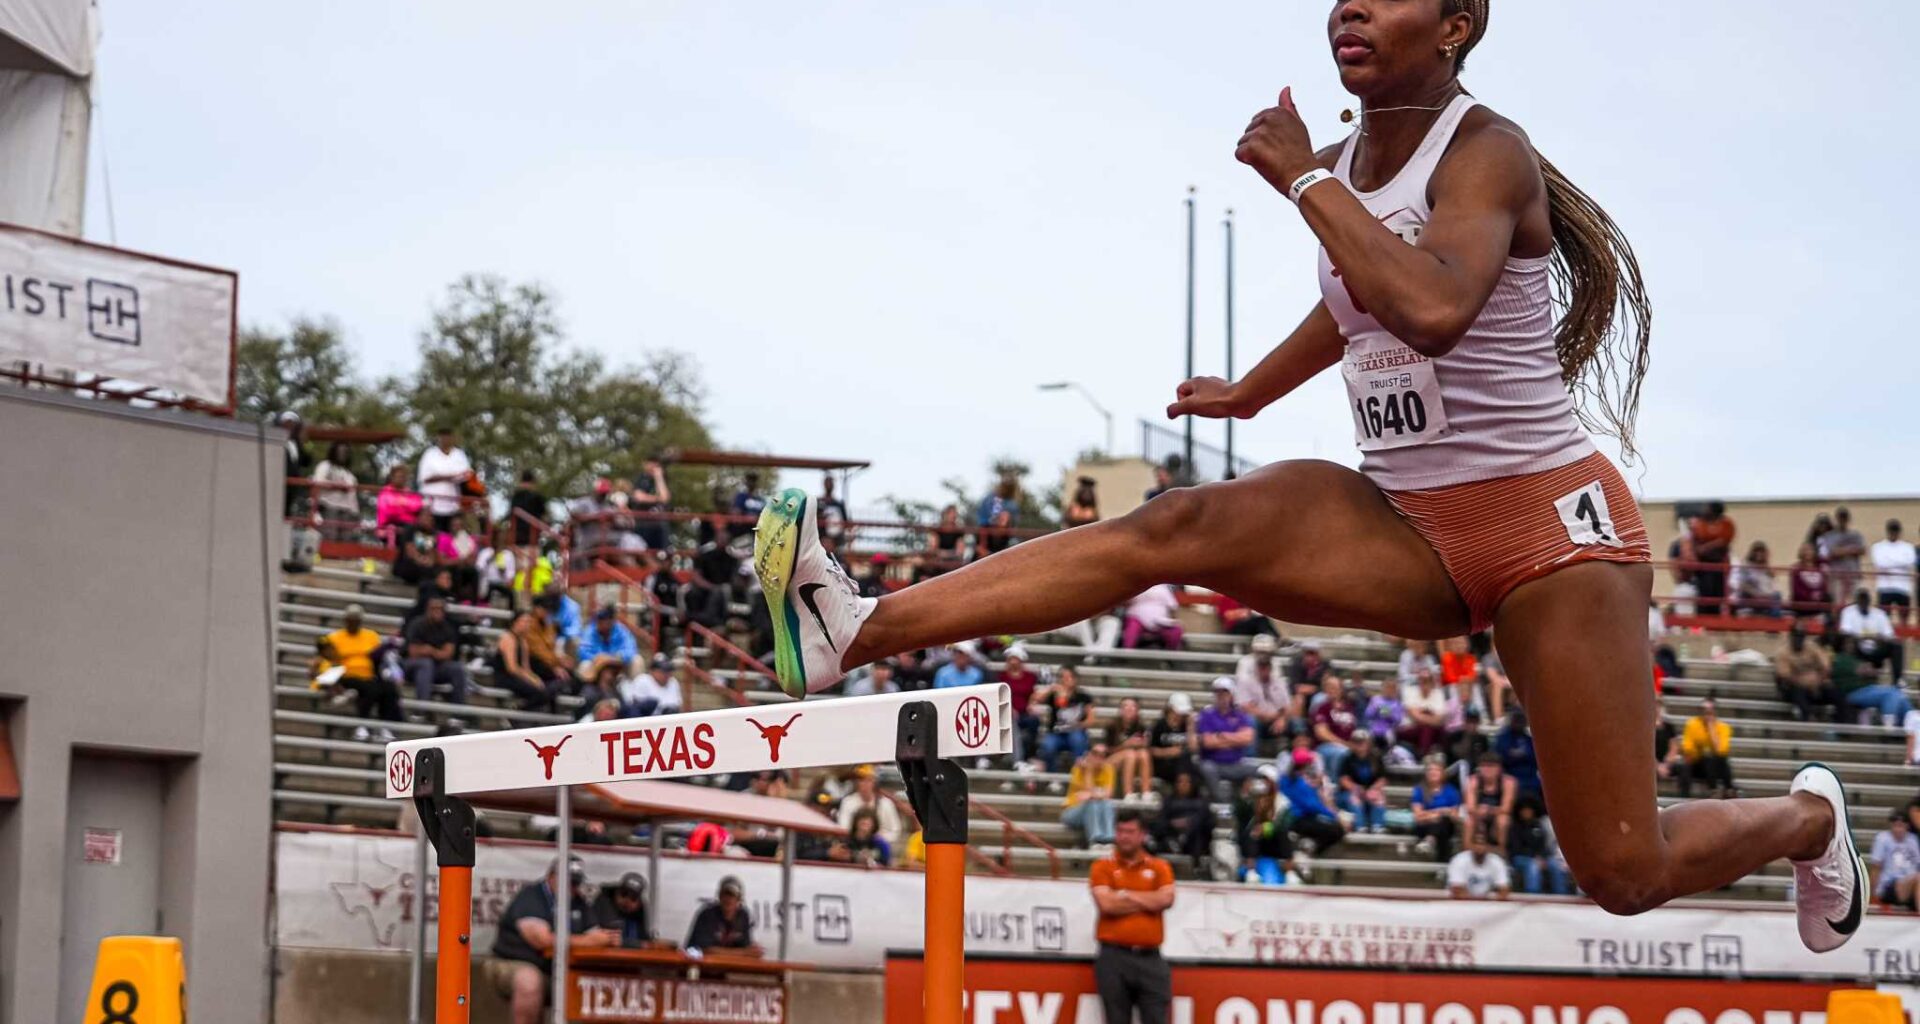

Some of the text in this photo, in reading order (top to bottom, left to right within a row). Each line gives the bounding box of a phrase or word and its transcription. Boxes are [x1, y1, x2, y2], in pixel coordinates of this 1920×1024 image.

[6, 274, 74, 319] IST
[1370, 377, 1398, 390] TRUIST
[1356, 390, 1427, 439] 1640
[955, 696, 990, 748] SEC
[390, 750, 412, 792] SEC
[600, 723, 716, 776] TEXAS
[964, 911, 1027, 942] UIST
[1249, 936, 1475, 967] TEXAS RELAYS
[1577, 938, 1694, 966] TRUIST
[577, 976, 783, 1022] TEXAS LONGHORNS
